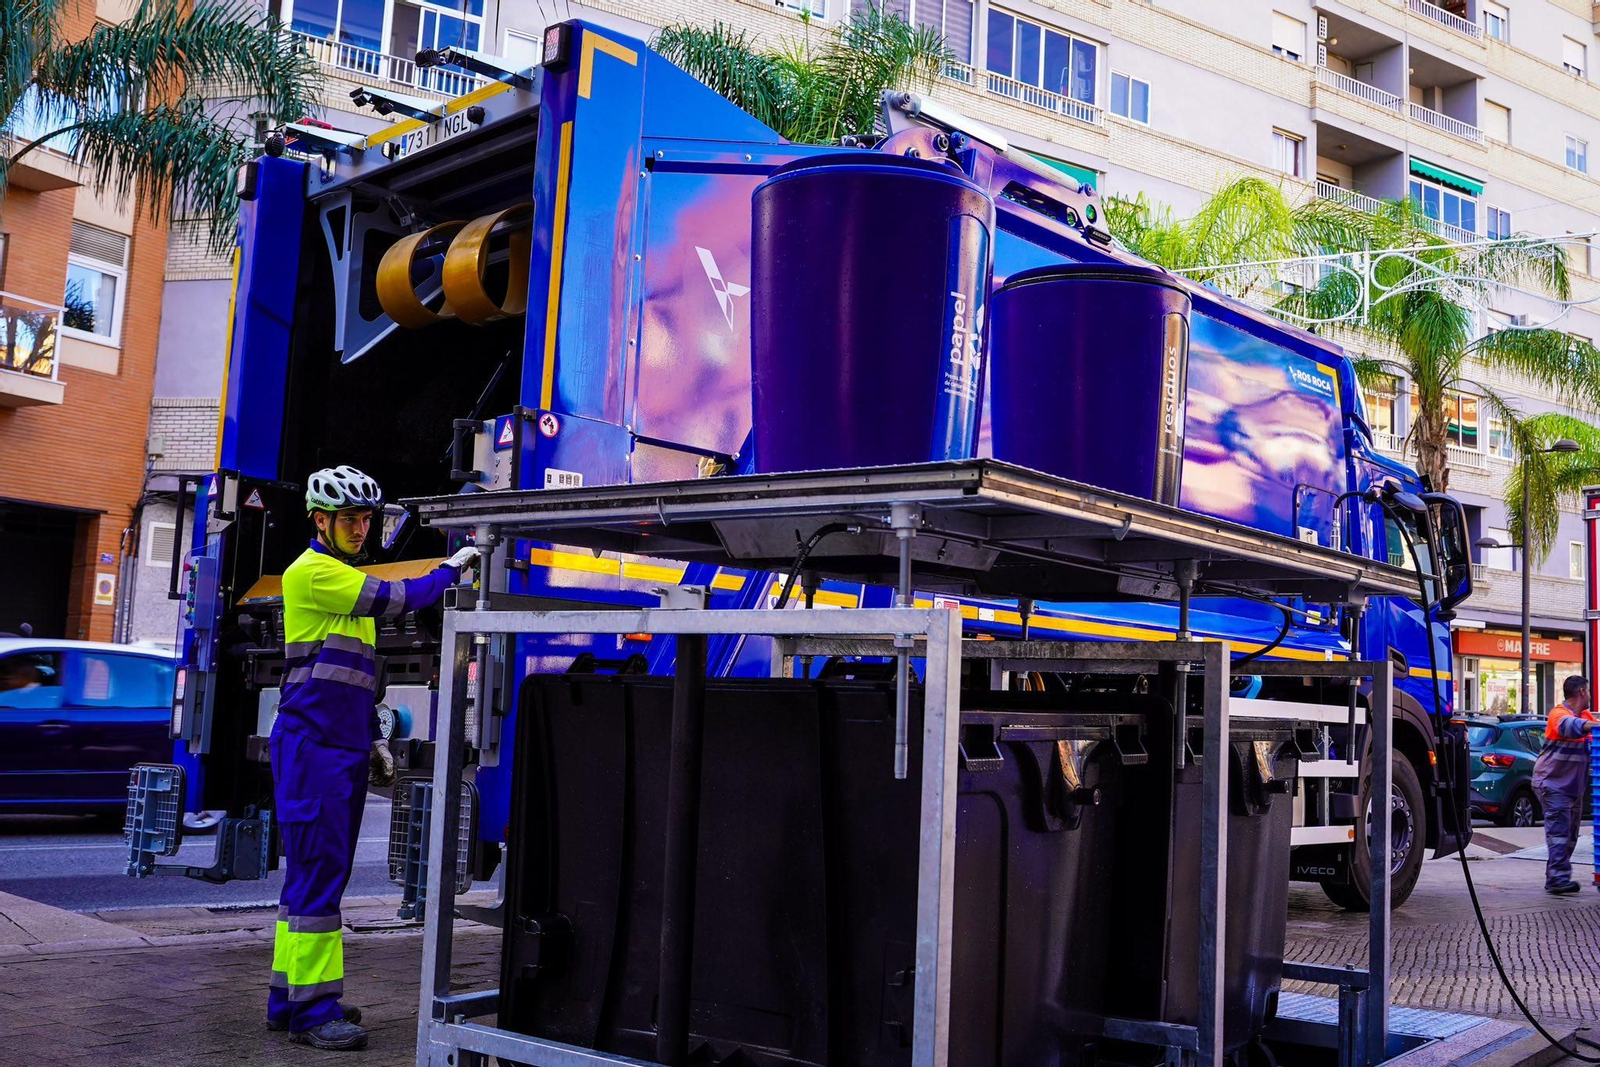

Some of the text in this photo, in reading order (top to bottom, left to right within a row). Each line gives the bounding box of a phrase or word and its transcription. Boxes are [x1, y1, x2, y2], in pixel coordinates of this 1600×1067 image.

[408, 113, 468, 153] 7311 NGL
[950, 291, 967, 365] papel
[1164, 346, 1177, 434] residuos
[1297, 369, 1311, 383] ROS
[1311, 375, 1331, 391] ROCA
[1505, 640, 1550, 655] MAFRE
[1297, 866, 1335, 875] IVECO
